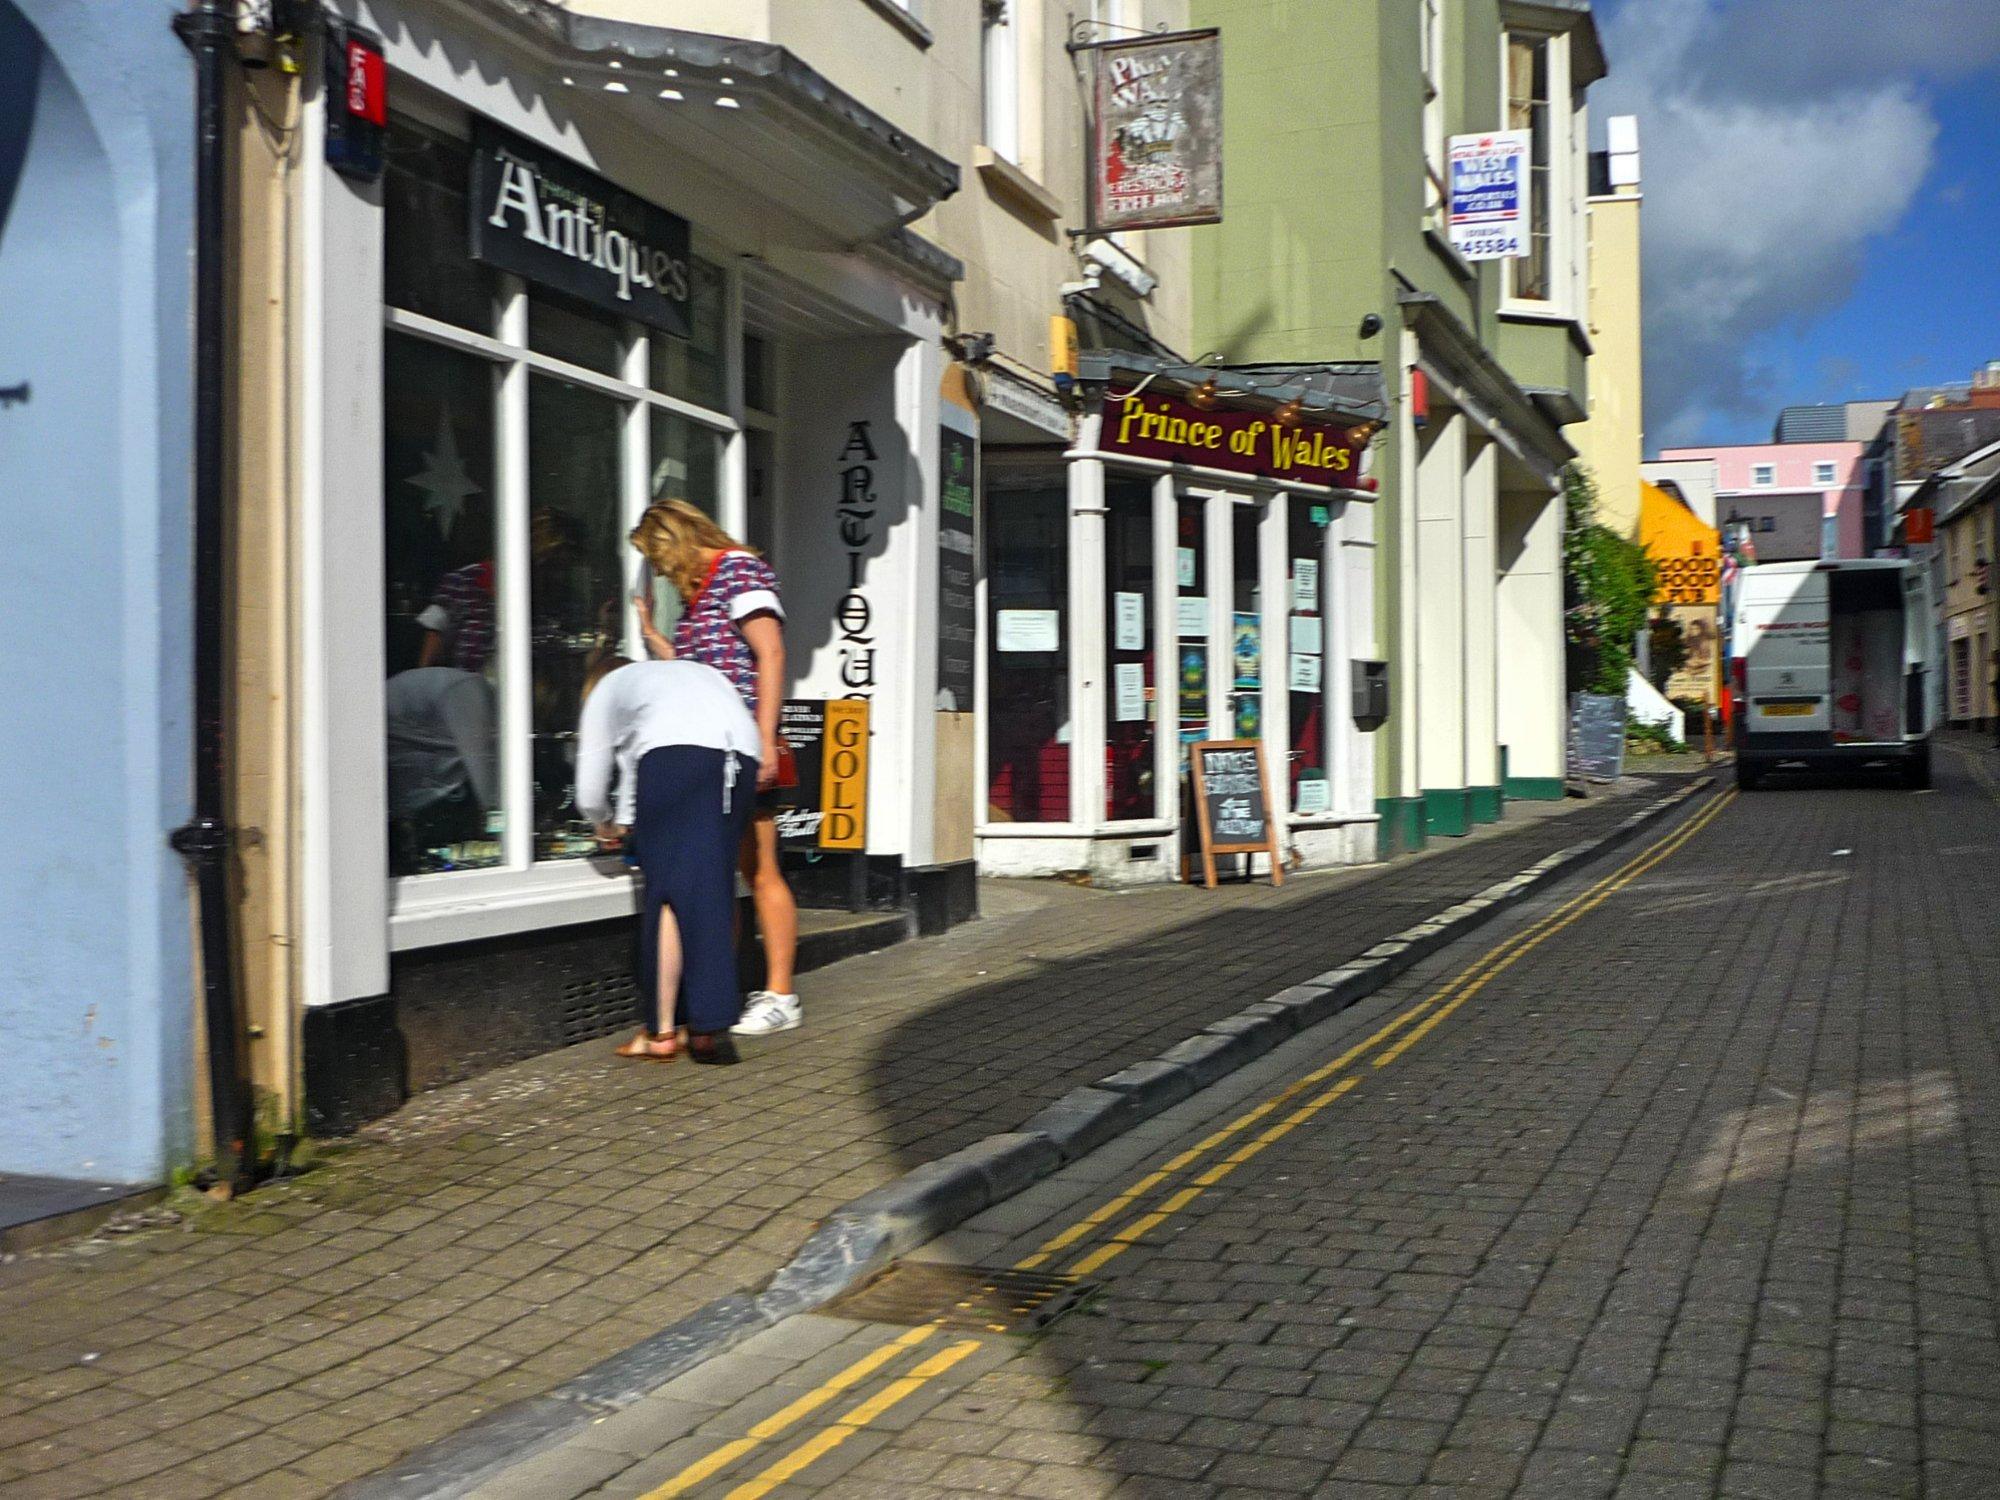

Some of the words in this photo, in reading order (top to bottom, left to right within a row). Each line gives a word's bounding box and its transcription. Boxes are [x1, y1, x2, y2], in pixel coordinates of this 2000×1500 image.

[1455, 170, 1515, 188] WALES
[1461, 156, 1508, 174] WEST
[489, 150, 688, 301] Antiques
[1116, 396, 1222, 450] Prince
[1229, 420, 1266, 456] of
[1270, 424, 1350, 471] Wales
[828, 718, 860, 841] GOLD
